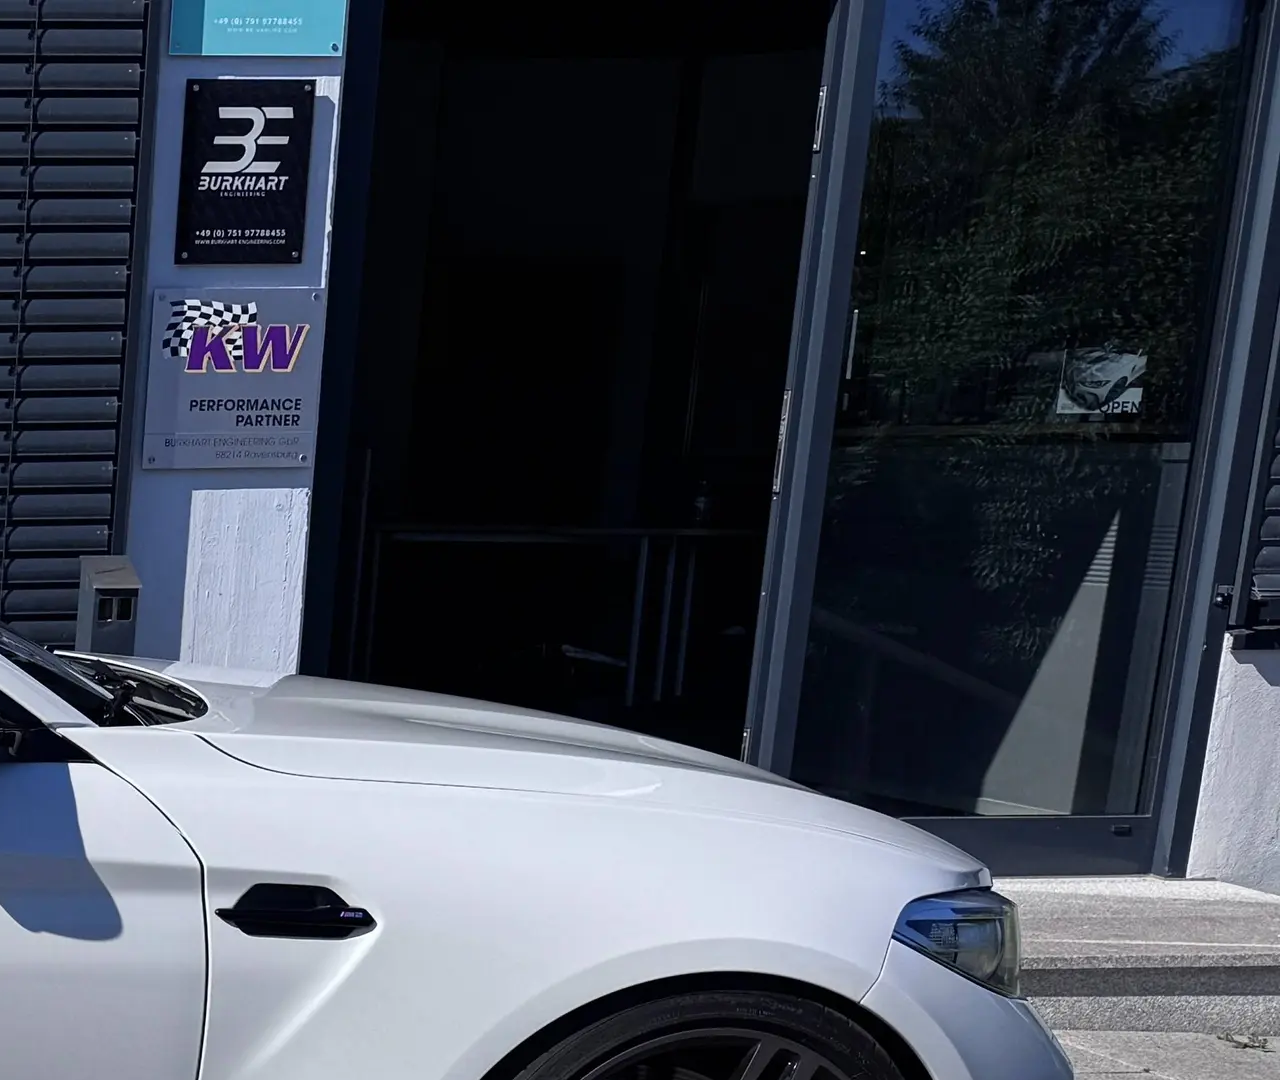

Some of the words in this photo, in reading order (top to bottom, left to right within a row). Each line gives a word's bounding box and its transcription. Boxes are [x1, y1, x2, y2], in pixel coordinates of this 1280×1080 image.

[197, 176, 289, 191] BURKHART
[195, 229, 211, 237] +49
[213, 229, 225, 238] (0)
[227, 229, 242, 237] 751
[244, 229, 286, 237] 97788455
[184, 323, 310, 373] KW
[189, 398, 302, 412] PERFORMANCE
[1099, 401, 1141, 414] OPEN
[235, 414, 301, 427] PARTNER
[244, 450, 299, 460] Ravensburg
